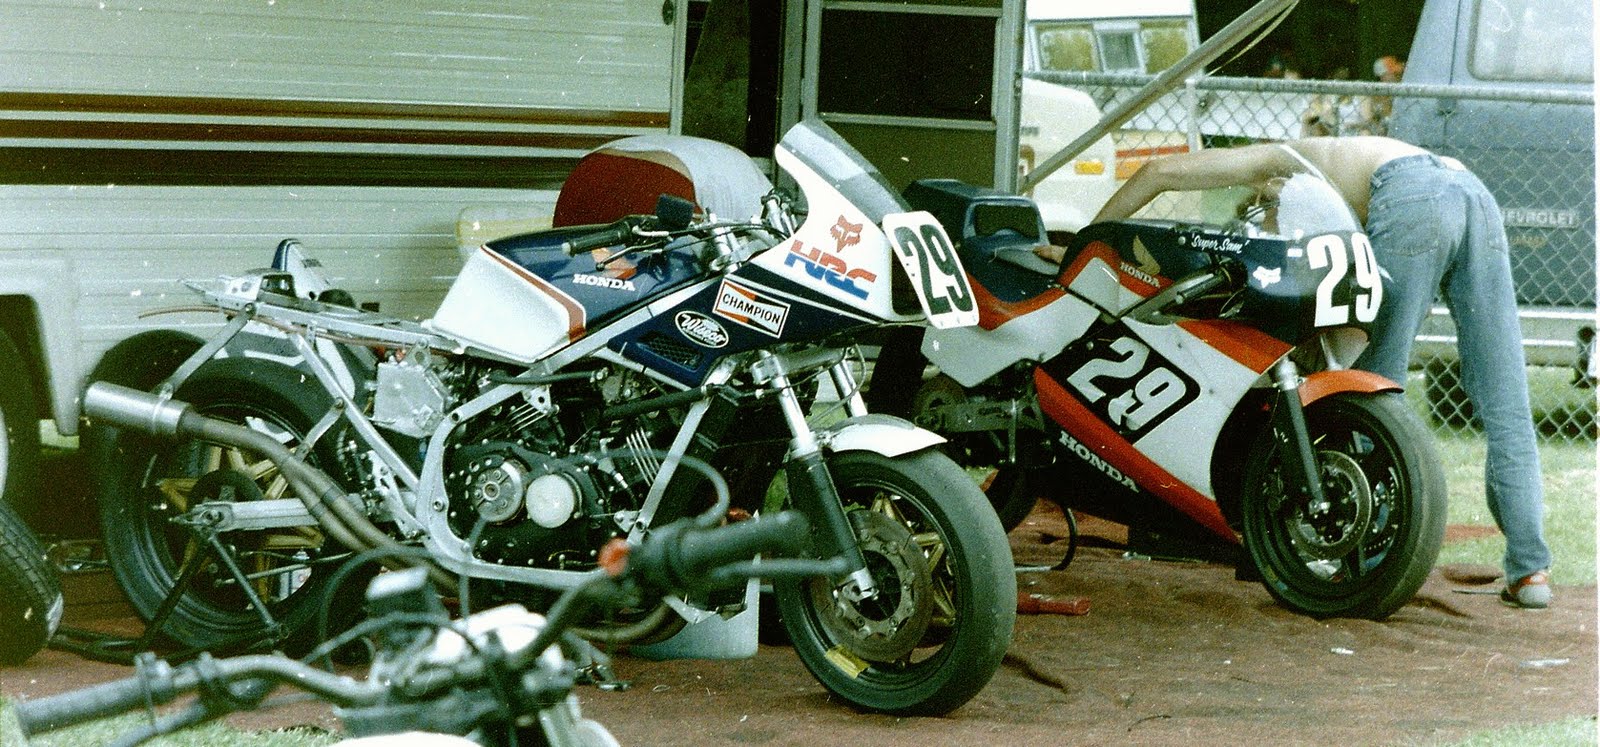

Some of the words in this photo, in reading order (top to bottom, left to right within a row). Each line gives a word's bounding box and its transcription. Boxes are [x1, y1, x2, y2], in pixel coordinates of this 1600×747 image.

[572, 273, 636, 292] HONDA
[784, 239, 877, 300] HRC
[894, 224, 974, 314] 29
[1120, 261, 1161, 289] HONDA
[1307, 233, 1383, 327] 29
[681, 313, 727, 343] Wiseco
[722, 293, 781, 324] CHAMPION
[1067, 337, 1186, 430] 29
[1059, 431, 1139, 492] HONDA
